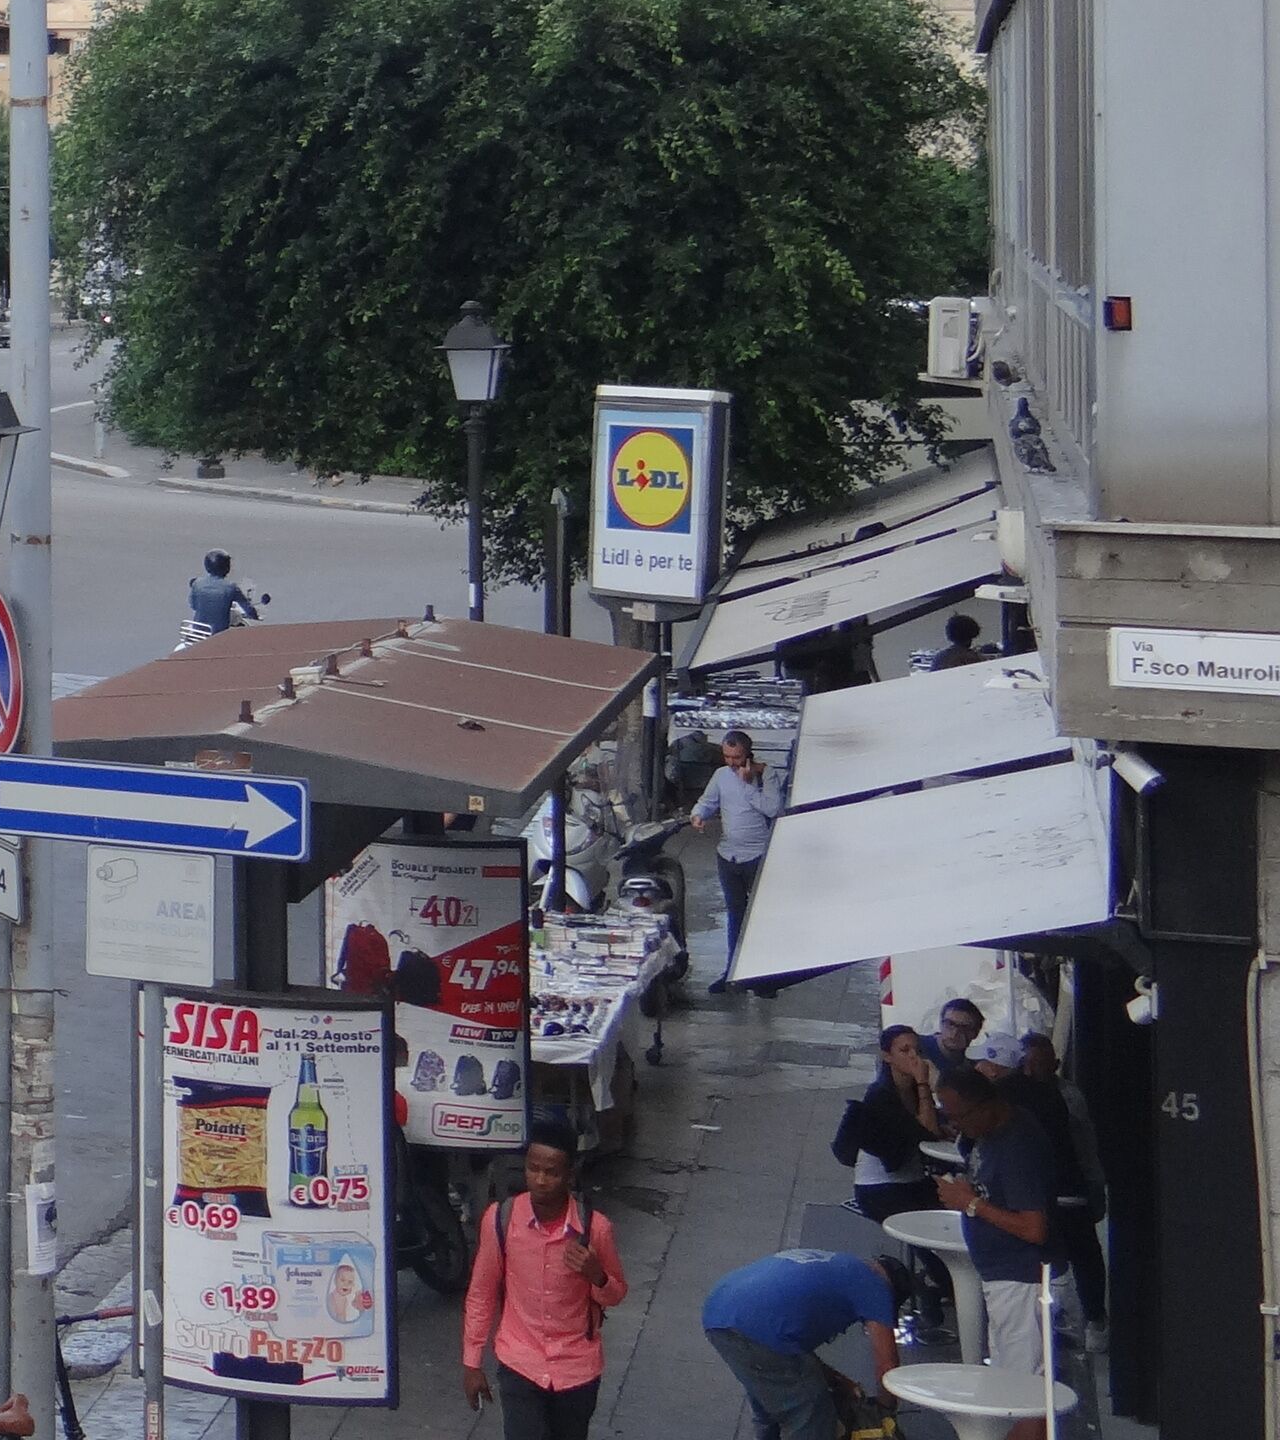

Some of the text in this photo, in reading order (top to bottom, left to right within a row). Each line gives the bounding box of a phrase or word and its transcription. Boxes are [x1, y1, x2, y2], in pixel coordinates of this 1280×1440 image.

[601, 547, 693, 572] Lidl è per te
[1131, 641, 1154, 652] Via
[1131, 657, 1190, 677] F.sco
[391, 862, 478, 876] DOUBLE PROJECT
[155, 899, 207, 922] AREA
[449, 958, 520, 991] 47,94
[169, 1002, 259, 1054] SISA
[274, 1029, 373, 1042] dal 29 Agosto
[455, 1026, 482, 1038] NEW
[266, 1041, 381, 1054] al 11 Settembre
[1160, 1091, 1200, 1121] 45
[195, 1118, 246, 1136] Poiatti
[293, 1177, 368, 1205] € 0,75
[167, 1204, 239, 1232] € 0,69
[204, 1285, 277, 1313] € 1,89
